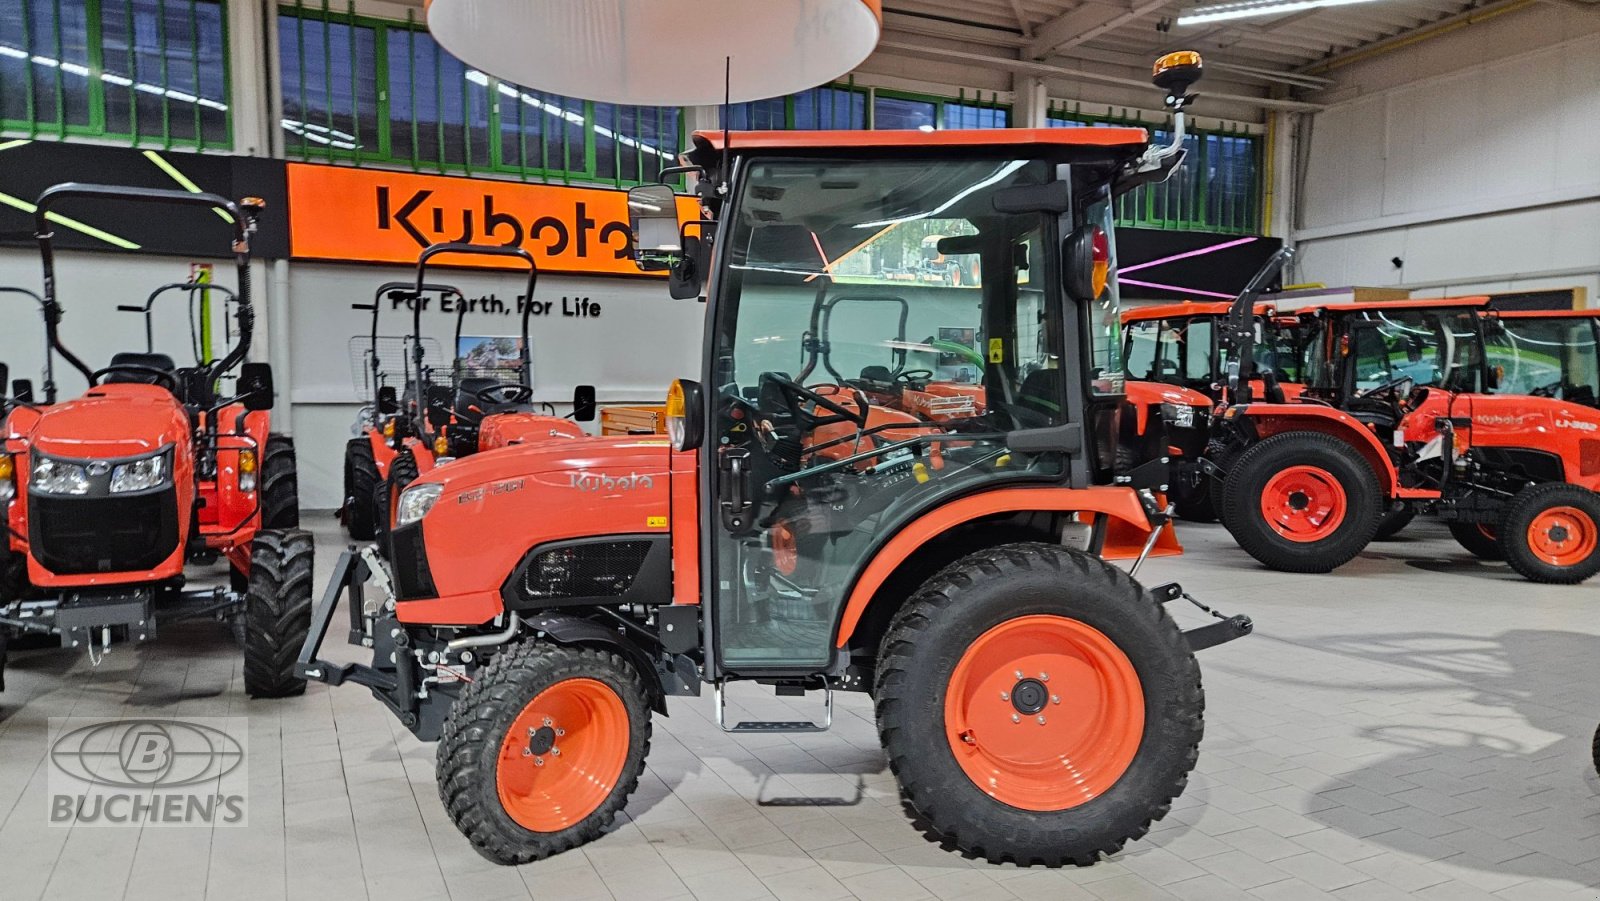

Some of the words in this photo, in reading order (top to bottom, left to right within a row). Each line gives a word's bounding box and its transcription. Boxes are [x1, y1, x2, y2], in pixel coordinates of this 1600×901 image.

[376, 185, 635, 260] Kubota
[562, 296, 602, 317] Life
[1476, 414, 1524, 425] Kubota
[570, 471, 654, 492] Kubota
